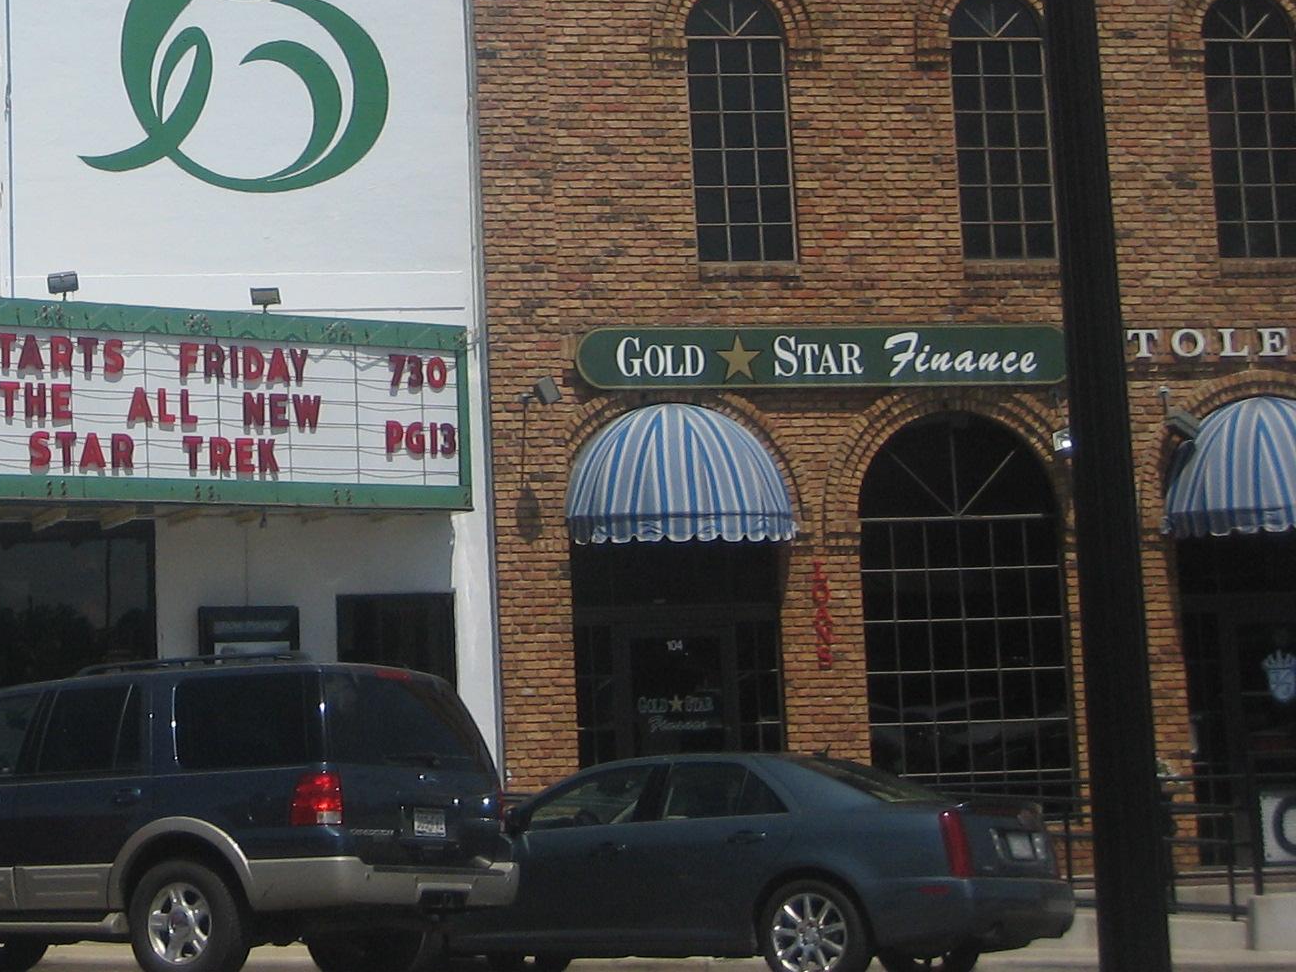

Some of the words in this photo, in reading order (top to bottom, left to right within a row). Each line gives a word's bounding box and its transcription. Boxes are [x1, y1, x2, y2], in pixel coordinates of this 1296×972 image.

[179, 342, 309, 384] FRIDAY
[388, 354, 449, 390] 730
[615, 336, 705, 378] GOLD
[773, 334, 864, 378] STAR
[883, 331, 1038, 378] Finance
[127, 386, 198, 425] ALL
[242, 391, 321, 433] NEW
[29, 431, 135, 473] STAR
[182, 435, 280, 477] TREK
[384, 419, 457, 458] PG13
